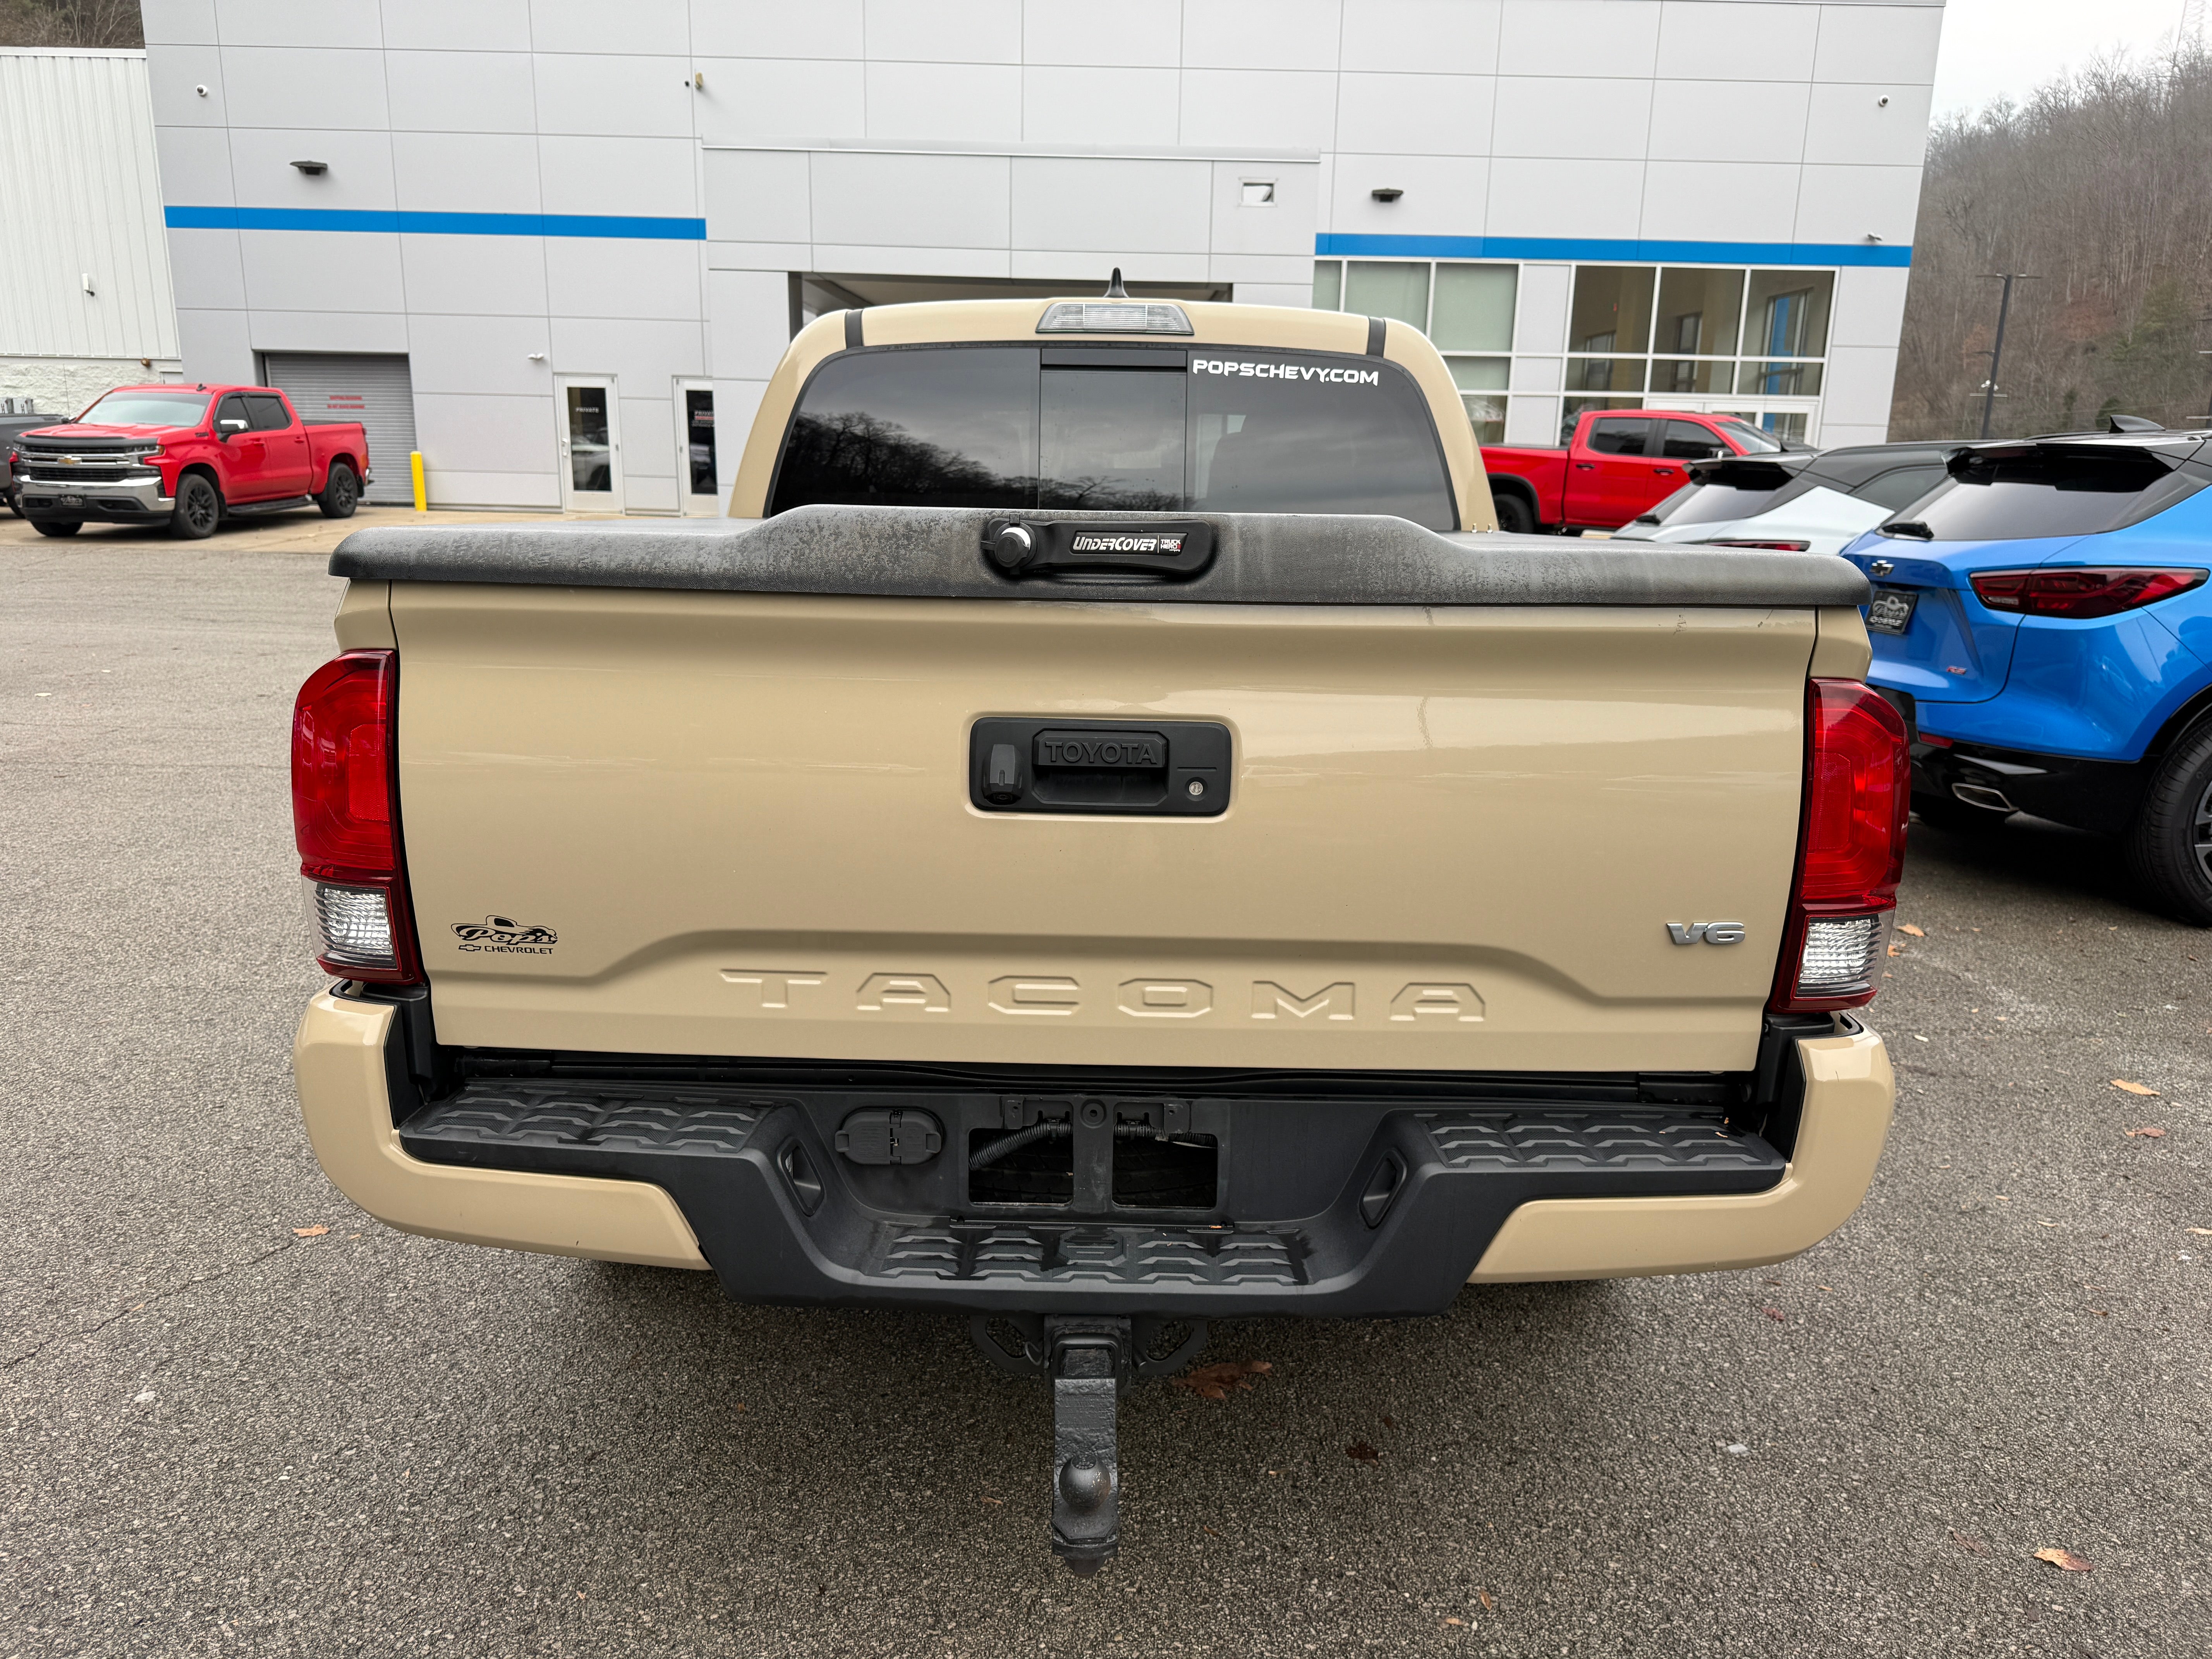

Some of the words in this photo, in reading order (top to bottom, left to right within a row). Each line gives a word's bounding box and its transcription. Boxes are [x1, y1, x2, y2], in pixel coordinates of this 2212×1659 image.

[1192, 359, 1379, 386] POPSCHEVY.COM
[1044, 741, 1158, 765] TOYOTA
[1666, 921, 1745, 945] V6
[484, 946, 554, 955] CHEVROLET
[719, 968, 1486, 1022] TACOMA
